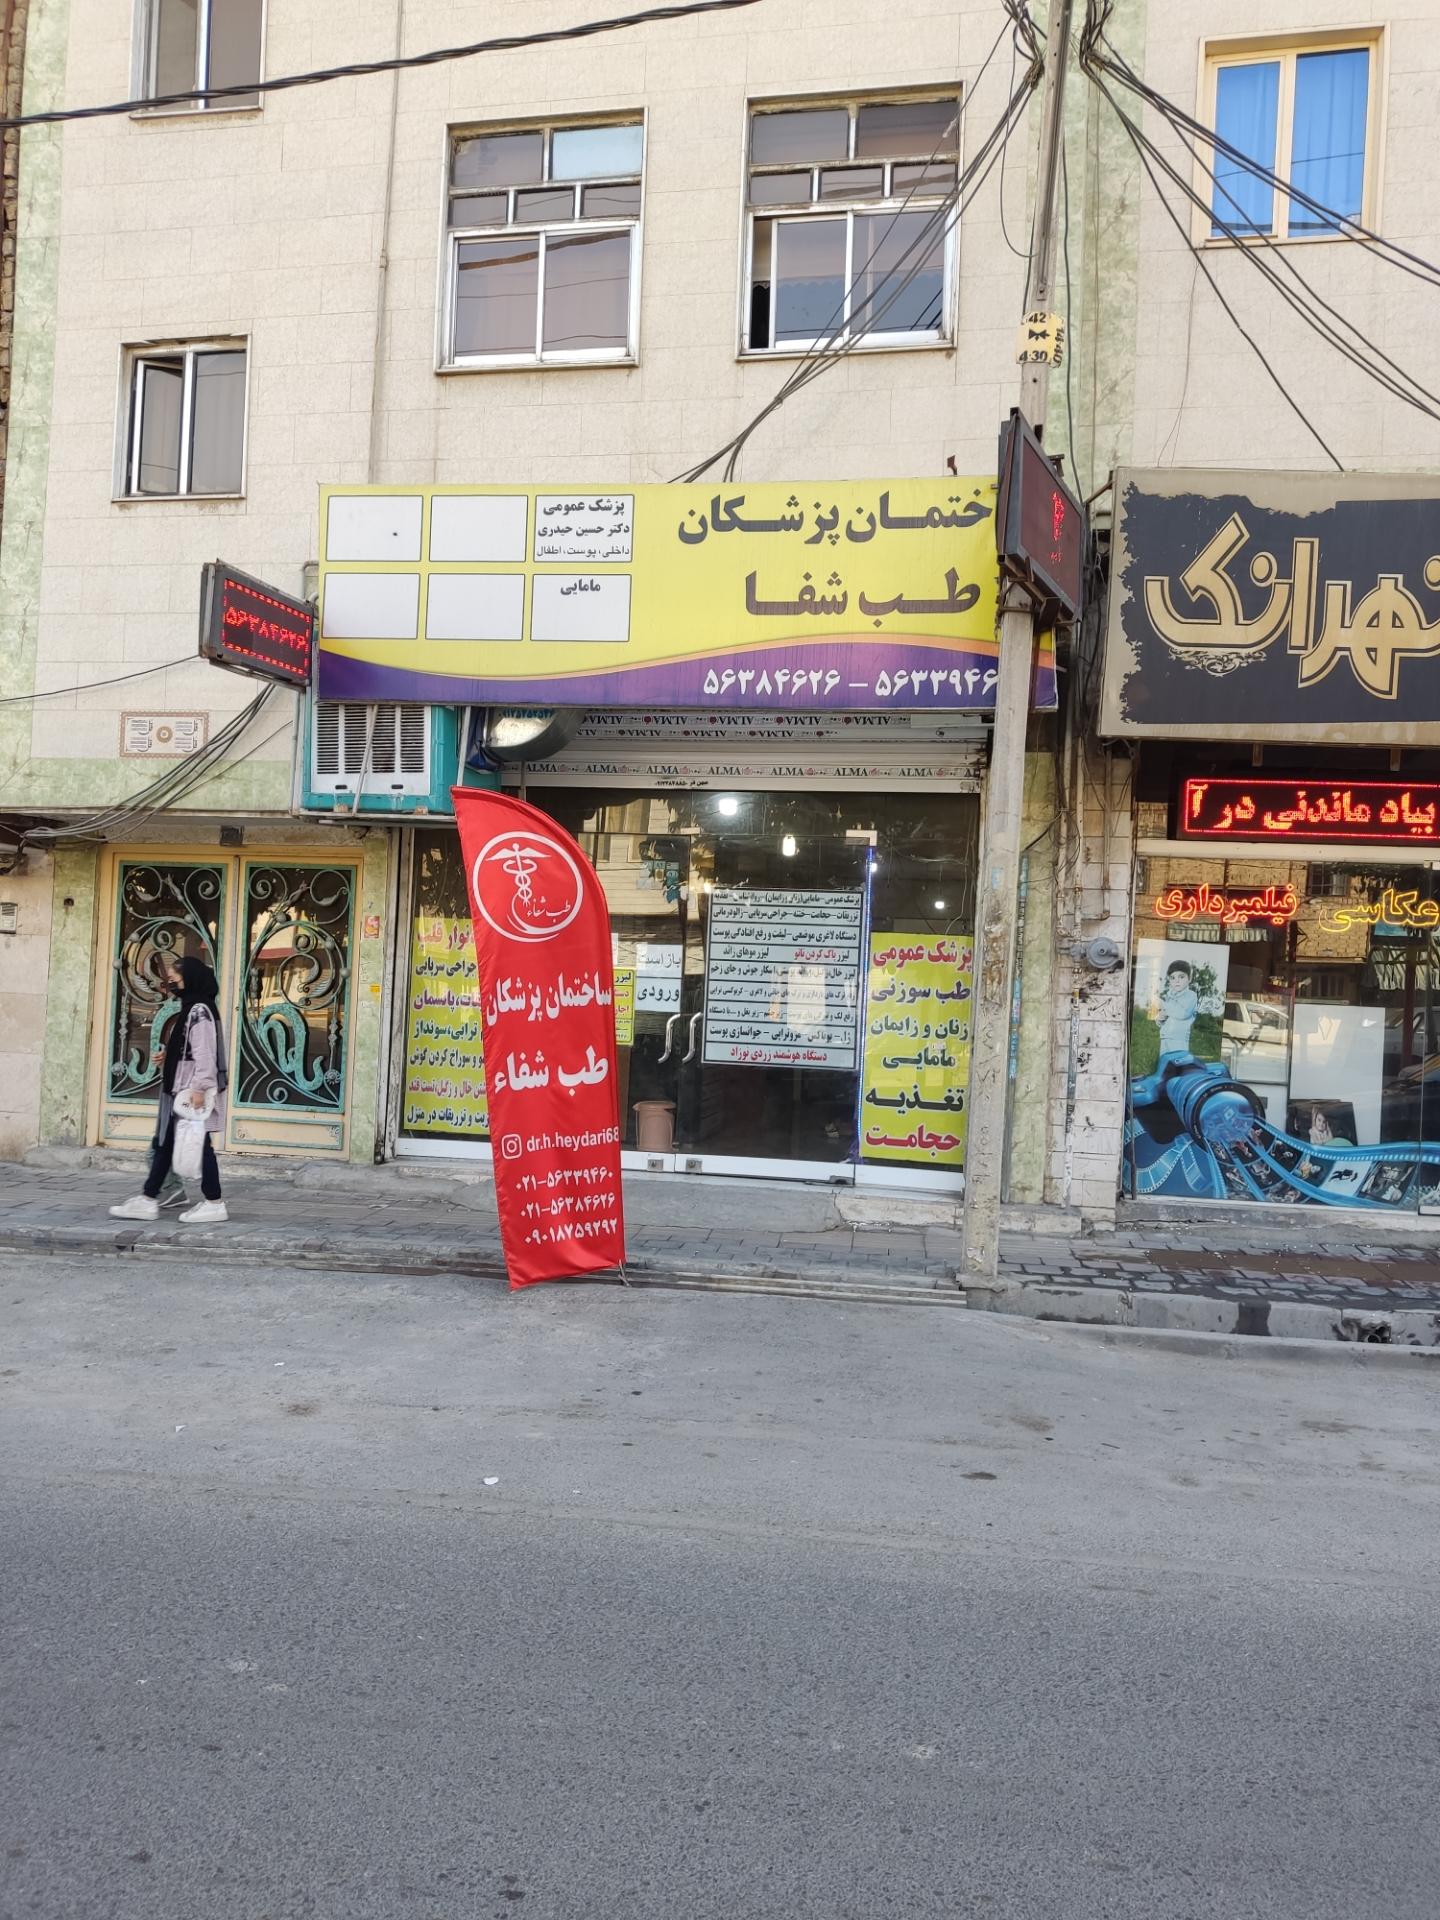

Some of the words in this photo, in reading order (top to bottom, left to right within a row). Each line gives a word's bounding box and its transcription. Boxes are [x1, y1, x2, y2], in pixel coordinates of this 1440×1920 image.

[543, 501, 585, 516] عمومی
[589, 498, 625, 516] پزشک
[679, 494, 840, 545] پزشکان
[846, 488, 993, 542] ختمان
[538, 525, 573, 537] حیدری
[576, 526, 604, 537] حسین
[607, 523, 630, 537] دکتر
[537, 546, 561, 557] اطفال
[560, 578, 601, 595] مامایی
[745, 570, 848, 616] شفا
[858, 567, 980, 628] طب
[1143, 512, 1440, 700] هرانک
[703, 668, 841, 696] ۵۶۳۸۴۶۲۶
[875, 668, 998, 697] ۵۶۳۳۹۴۶
[526, 764, 557, 773] ALMA
[585, 765, 617, 773] ALMA
[646, 765, 680, 774] ALMA
[707, 766, 741, 775] ALMA
[770, 767, 804, 776] ALMA
[833, 767, 868, 776] ALMA
[899, 768, 933, 777] ALMA
[1213, 796, 1255, 828] در
[1263, 791, 1371, 830] ماندنی
[546, 900, 571, 923] طب
[1155, 883, 1298, 924] فیلمبرداری
[1319, 888, 1440, 932] عکاسی
[416, 957, 445, 977] سرپایی
[446, 960, 477, 977] جراحی
[664, 953, 681, 968] باز
[873, 945, 924, 968] عمومی
[928, 941, 972, 972] پزشک
[486, 976, 542, 1026] پزشکان
[545, 971, 613, 1019] ساختمان
[637, 985, 679, 1001] ورودی
[872, 977, 931, 1003] سوزنی
[936, 980, 971, 1004] طب
[871, 1015, 918, 1037] زایمان
[922, 1023, 931, 1038] و
[935, 1018, 968, 1040] زنان
[558, 1045, 608, 1096] طب
[882, 1047, 956, 1070] مامایی
[495, 1050, 549, 1094] شفاء
[865, 1084, 965, 1114] تغذیه
[526, 1126, 620, 1152] dr.h.heydari68
[866, 1124, 960, 1156] حجامت
